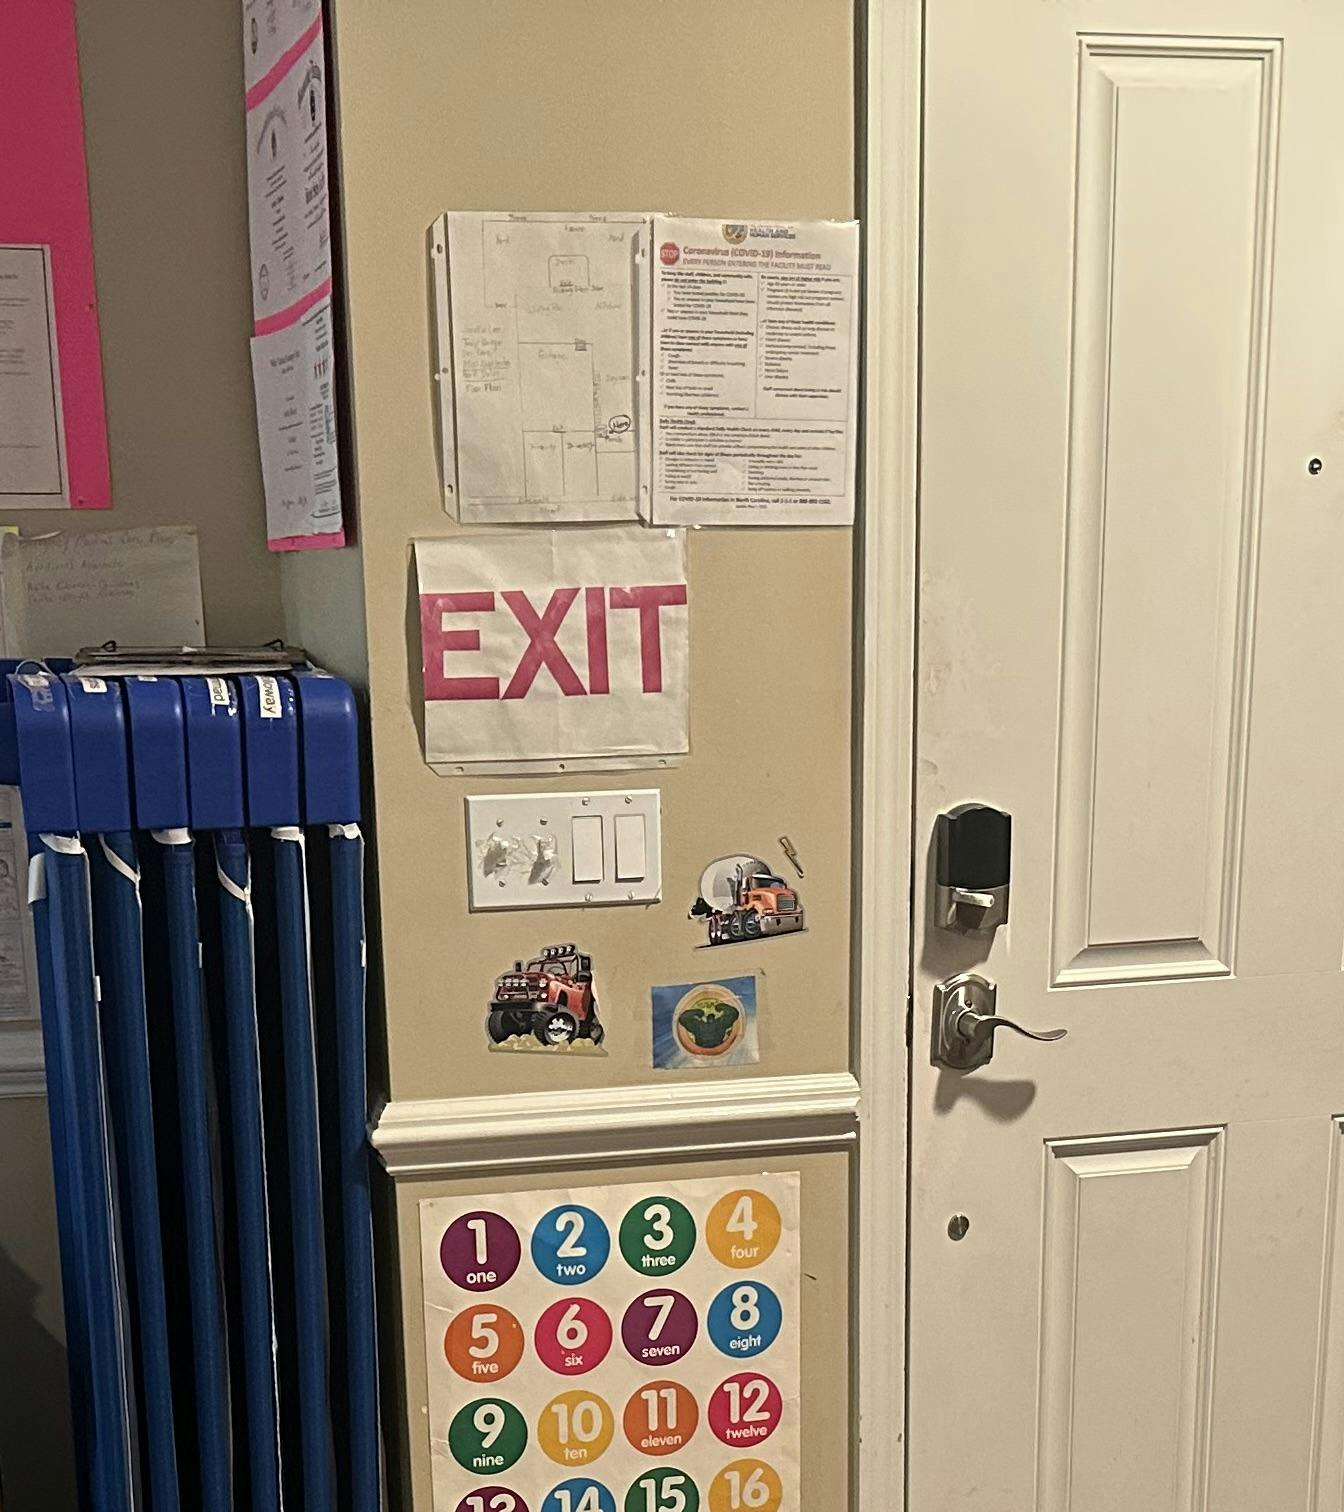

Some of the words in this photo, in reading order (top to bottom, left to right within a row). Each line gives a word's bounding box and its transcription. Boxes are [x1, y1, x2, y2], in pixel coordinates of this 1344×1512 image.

[661, 250, 678, 258] STOP
[683, 246, 729, 255] Coronavirus
[731, 249, 773, 258] (COVID-19)
[775, 251, 821, 259] Information
[420, 584, 687, 700] EXIT
[644, 1205, 674, 1251] 3
[726, 1196, 758, 1240] 4
[467, 1219, 489, 1265] 1
[555, 1211, 587, 1258] 2
[642, 1254, 676, 1268] three
[730, 1243, 760, 1259] four
[466, 1269, 497, 1285] one
[556, 1263, 586, 1277] two
[644, 1295, 675, 1341] 7
[730, 1287, 760, 1330] 8
[469, 1313, 499, 1359] 5
[556, 1304, 588, 1349] 6
[642, 1344, 680, 1357] seven
[730, 1335, 762, 1351] eight
[472, 1360, 499, 1375] five
[565, 1353, 583, 1367] six
[641, 1388, 678, 1431] 11
[723, 1380, 770, 1423] 12
[473, 1403, 505, 1449] 9
[551, 1402, 603, 1444] 10
[726, 1423, 767, 1439] twelve
[564, 1446, 587, 1460] ten
[641, 1433, 681, 1448] eleven
[473, 1454, 503, 1467] nine
[724, 1468, 770, 1510] 16
